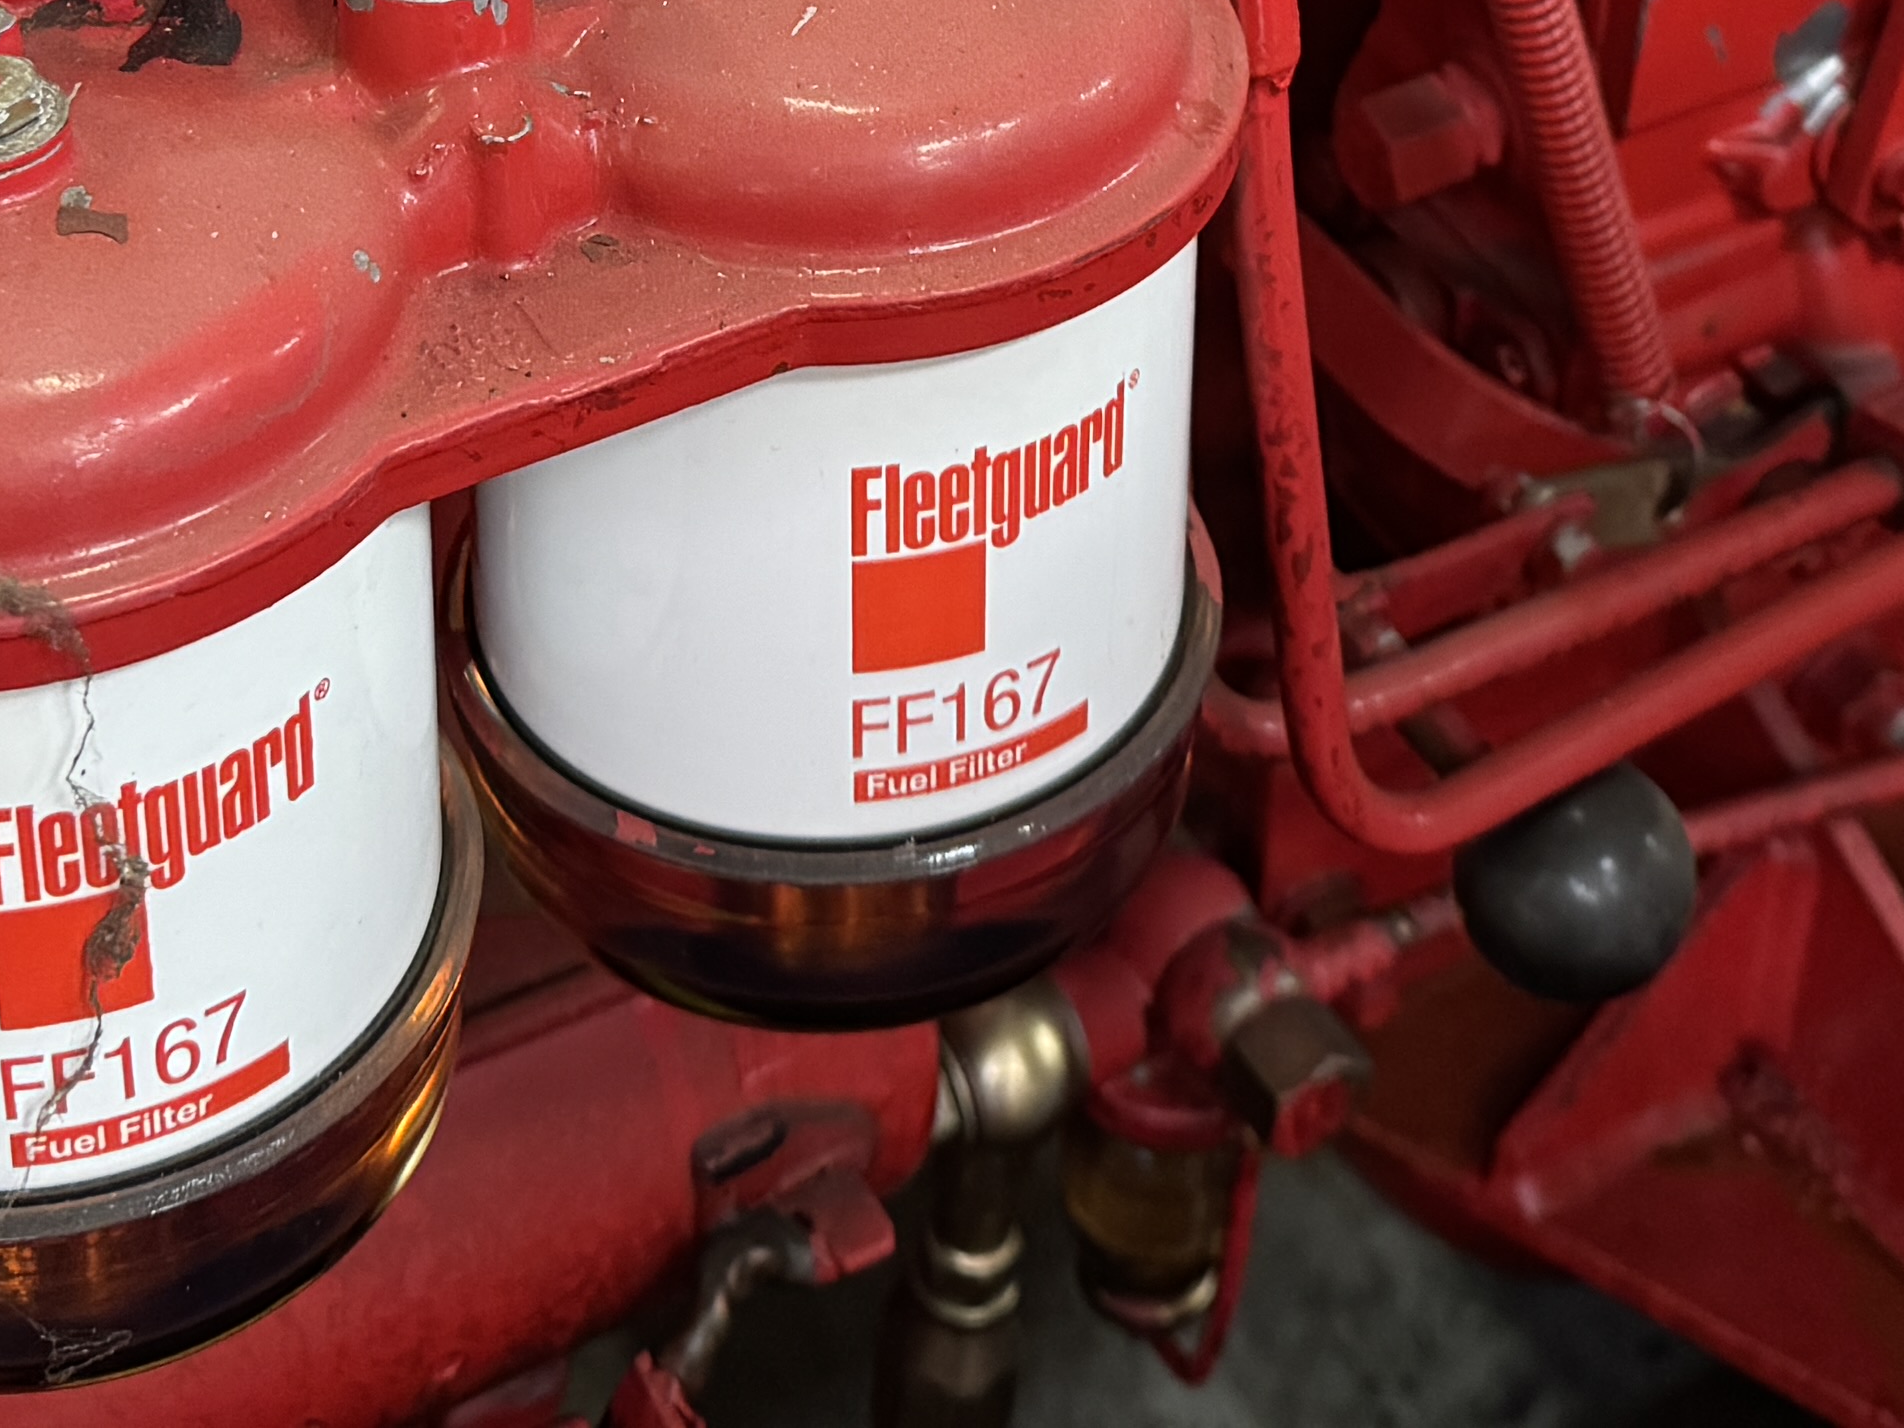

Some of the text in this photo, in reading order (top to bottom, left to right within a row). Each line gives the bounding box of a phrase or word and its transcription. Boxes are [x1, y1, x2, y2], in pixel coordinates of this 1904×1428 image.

[851, 645, 1062, 760] FF167
[865, 742, 1028, 798] Fuel Filter
[0, 988, 247, 1121] FF167
[24, 1091, 214, 1162] Fuel Filter
